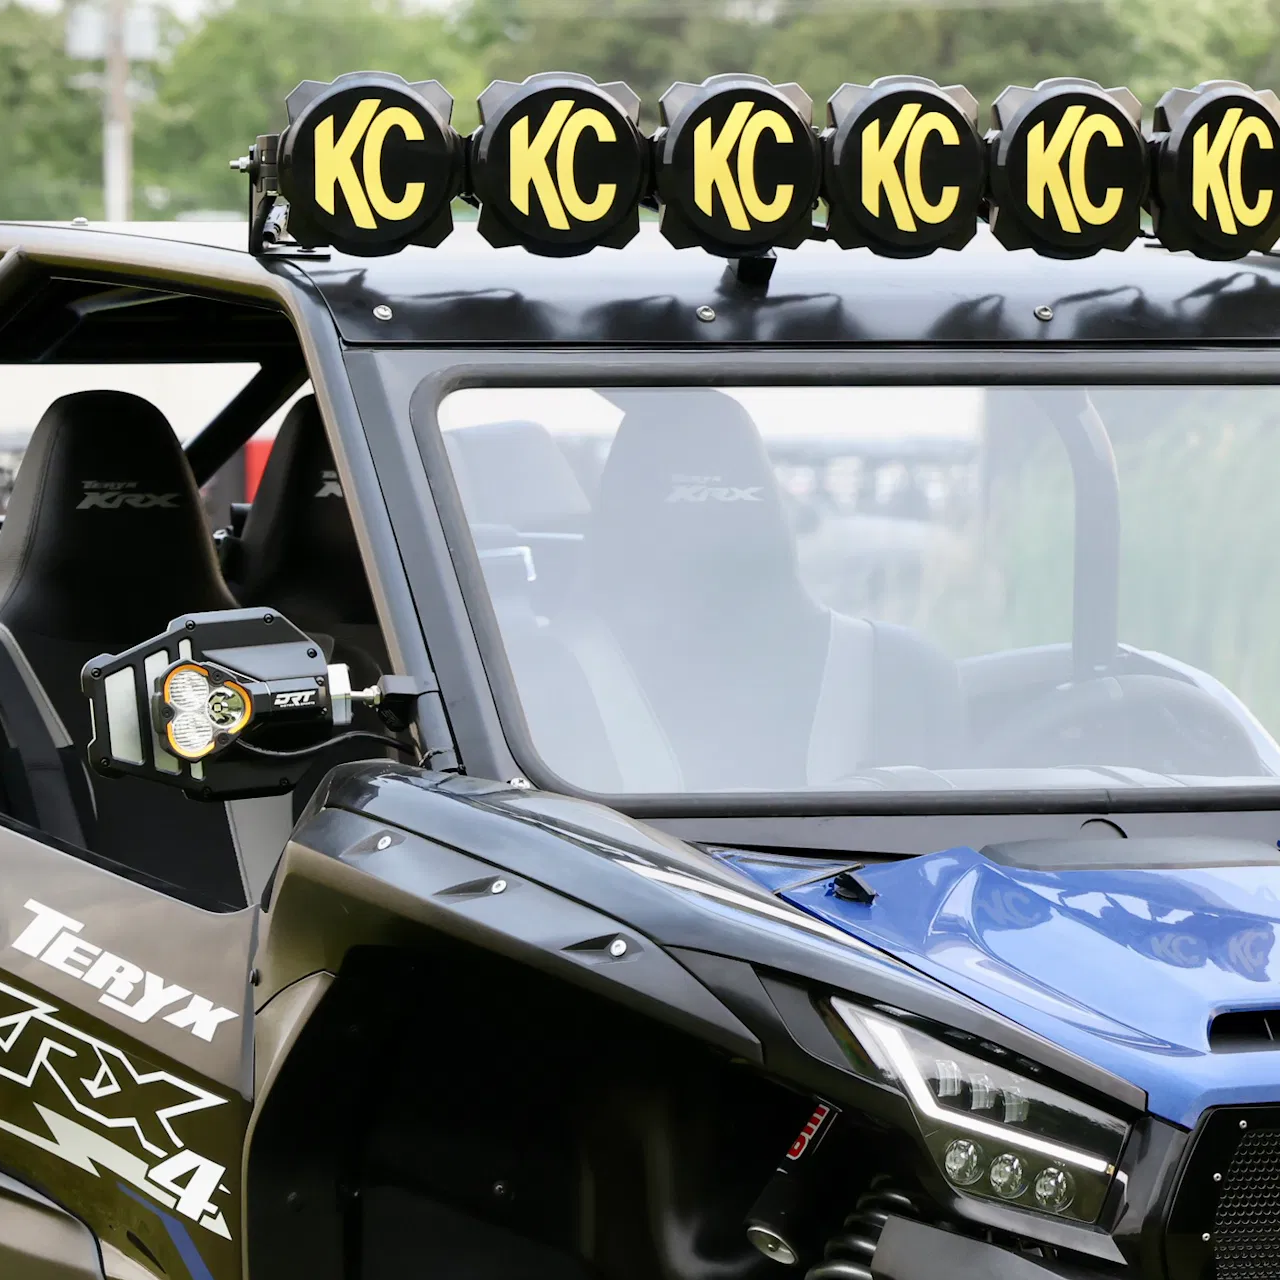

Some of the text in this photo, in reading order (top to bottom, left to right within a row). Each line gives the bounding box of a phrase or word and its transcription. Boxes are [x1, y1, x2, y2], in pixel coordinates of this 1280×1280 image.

[315, 98, 426, 229] KC
[510, 99, 617, 230] KC
[694, 101, 794, 231] KC
[861, 103, 960, 232] KC
[1027, 105, 1124, 234] KC
[1193, 107, 1274, 235] KC
[75, 491, 182, 509] KRX
[274, 690, 316, 706] DRT
[147, 1148, 227, 1222] 4
